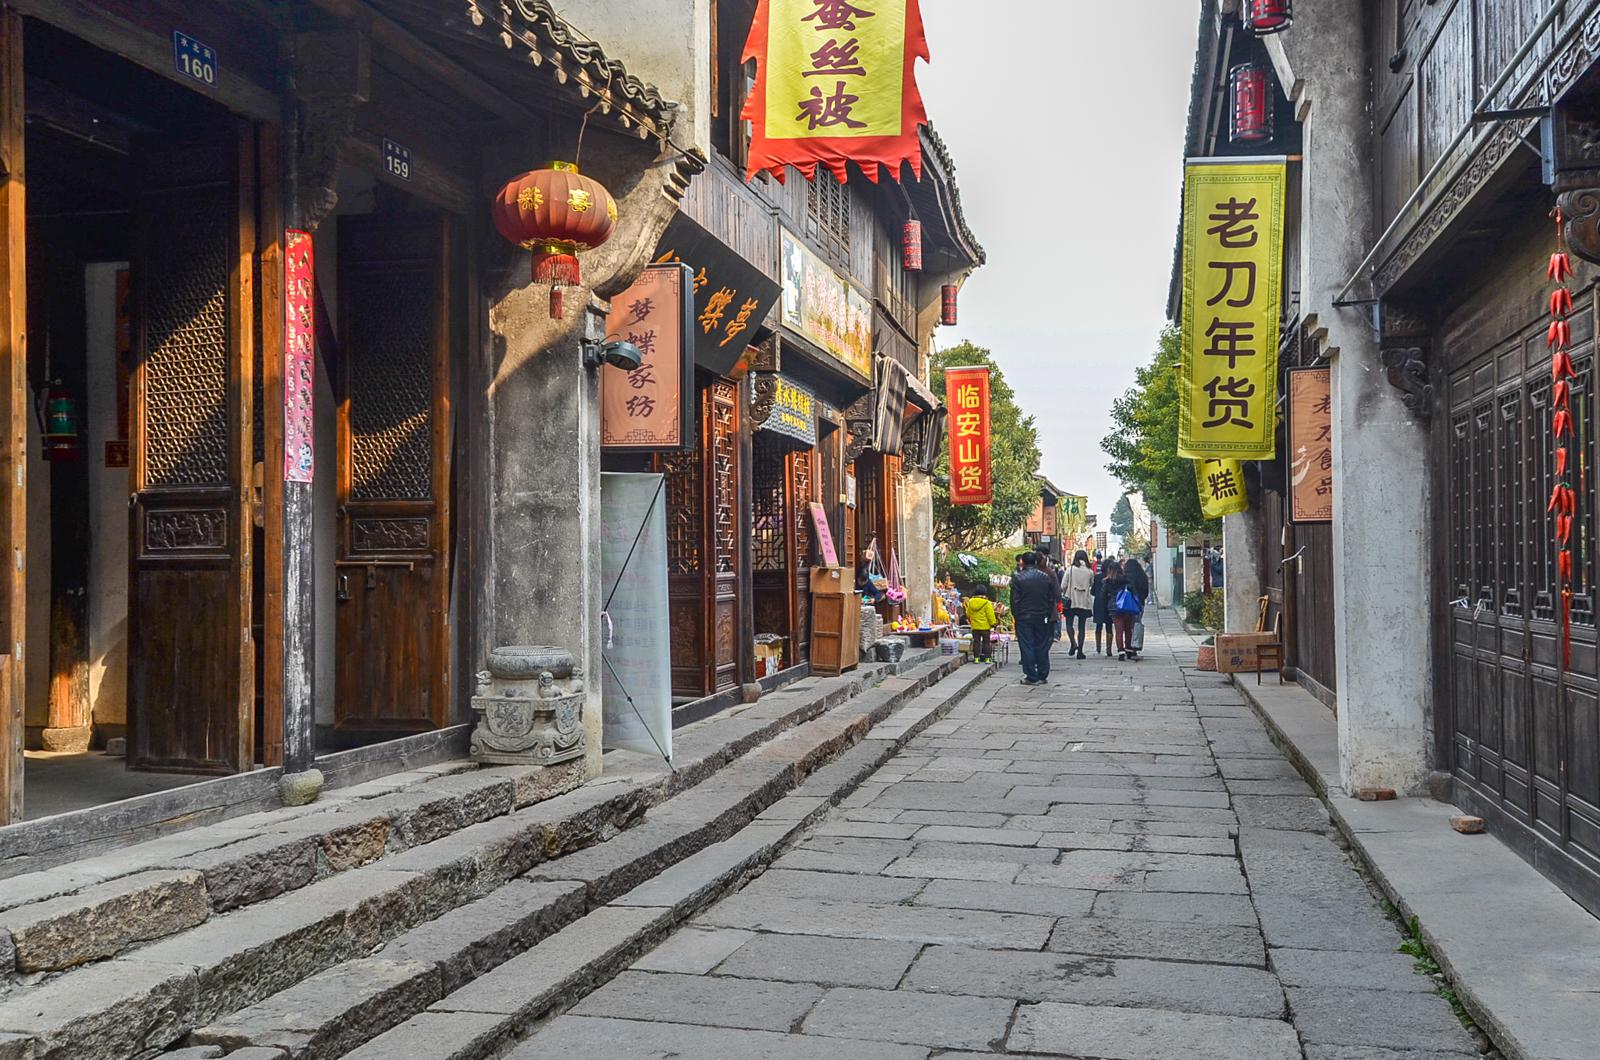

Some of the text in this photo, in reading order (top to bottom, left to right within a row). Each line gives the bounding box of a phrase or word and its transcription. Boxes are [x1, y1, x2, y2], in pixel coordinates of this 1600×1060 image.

[181, 53, 213, 83] 160
[795, 0, 876, 131] 蚕丝被
[387, 155, 409, 178] 159
[625, 297, 657, 418] 梦蝶家纺
[1202, 196, 1260, 430] 老刀年货
[956, 383, 983, 492] 临安山货
[1204, 458, 1239, 501] 糕
